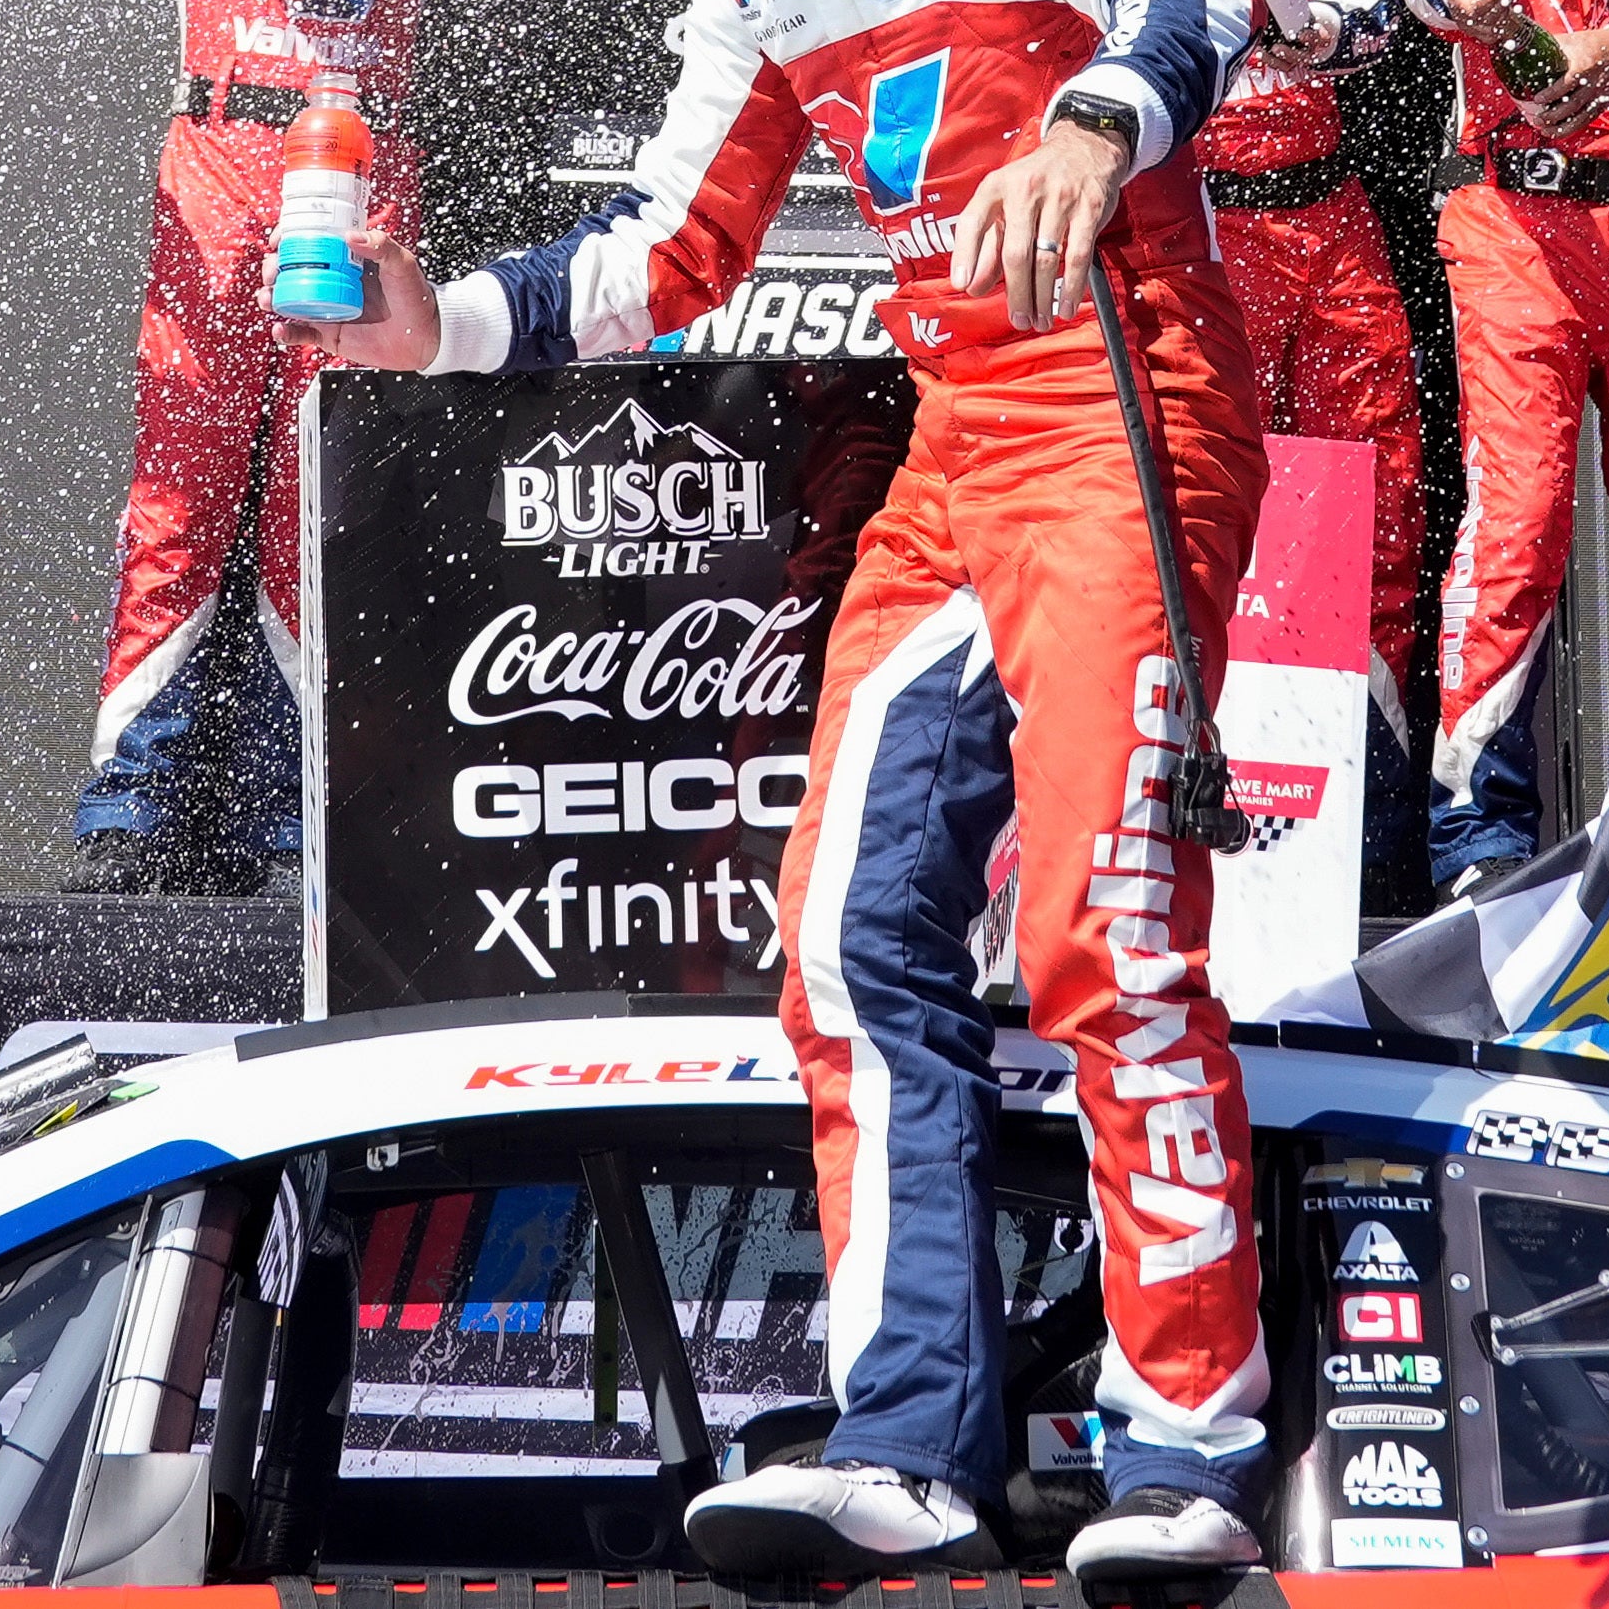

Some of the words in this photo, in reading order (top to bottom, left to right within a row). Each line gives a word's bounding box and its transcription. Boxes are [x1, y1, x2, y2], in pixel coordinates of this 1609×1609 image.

[573, 136, 635, 159] BUSCH
[685, 280, 899, 357] NASC
[501, 461, 770, 548] BUSCH
[555, 541, 704, 579] LIGHT
[447, 595, 824, 727] Coca-Cola
[451, 756, 811, 839] GEICO
[1223, 794, 1274, 807] OMPANIES
[1225, 779, 1263, 795] AVE
[1266, 782, 1315, 800] MART
[474, 857, 784, 979] xfinity
[1302, 1195, 1433, 1213] CHEVROLET
[1332, 1264, 1420, 1282] AXALTA
[1323, 1354, 1443, 1385] CLIMB
[1335, 1383, 1380, 1394] CHANNEL
[1381, 1383, 1433, 1394] SOLUTIONS
[1338, 1409, 1434, 1426] FREIGHTLINER
[1342, 1441, 1442, 1489] MAC
[1343, 1487, 1443, 1508] TOOLS
[1349, 1534, 1446, 1550] SIEMENS
